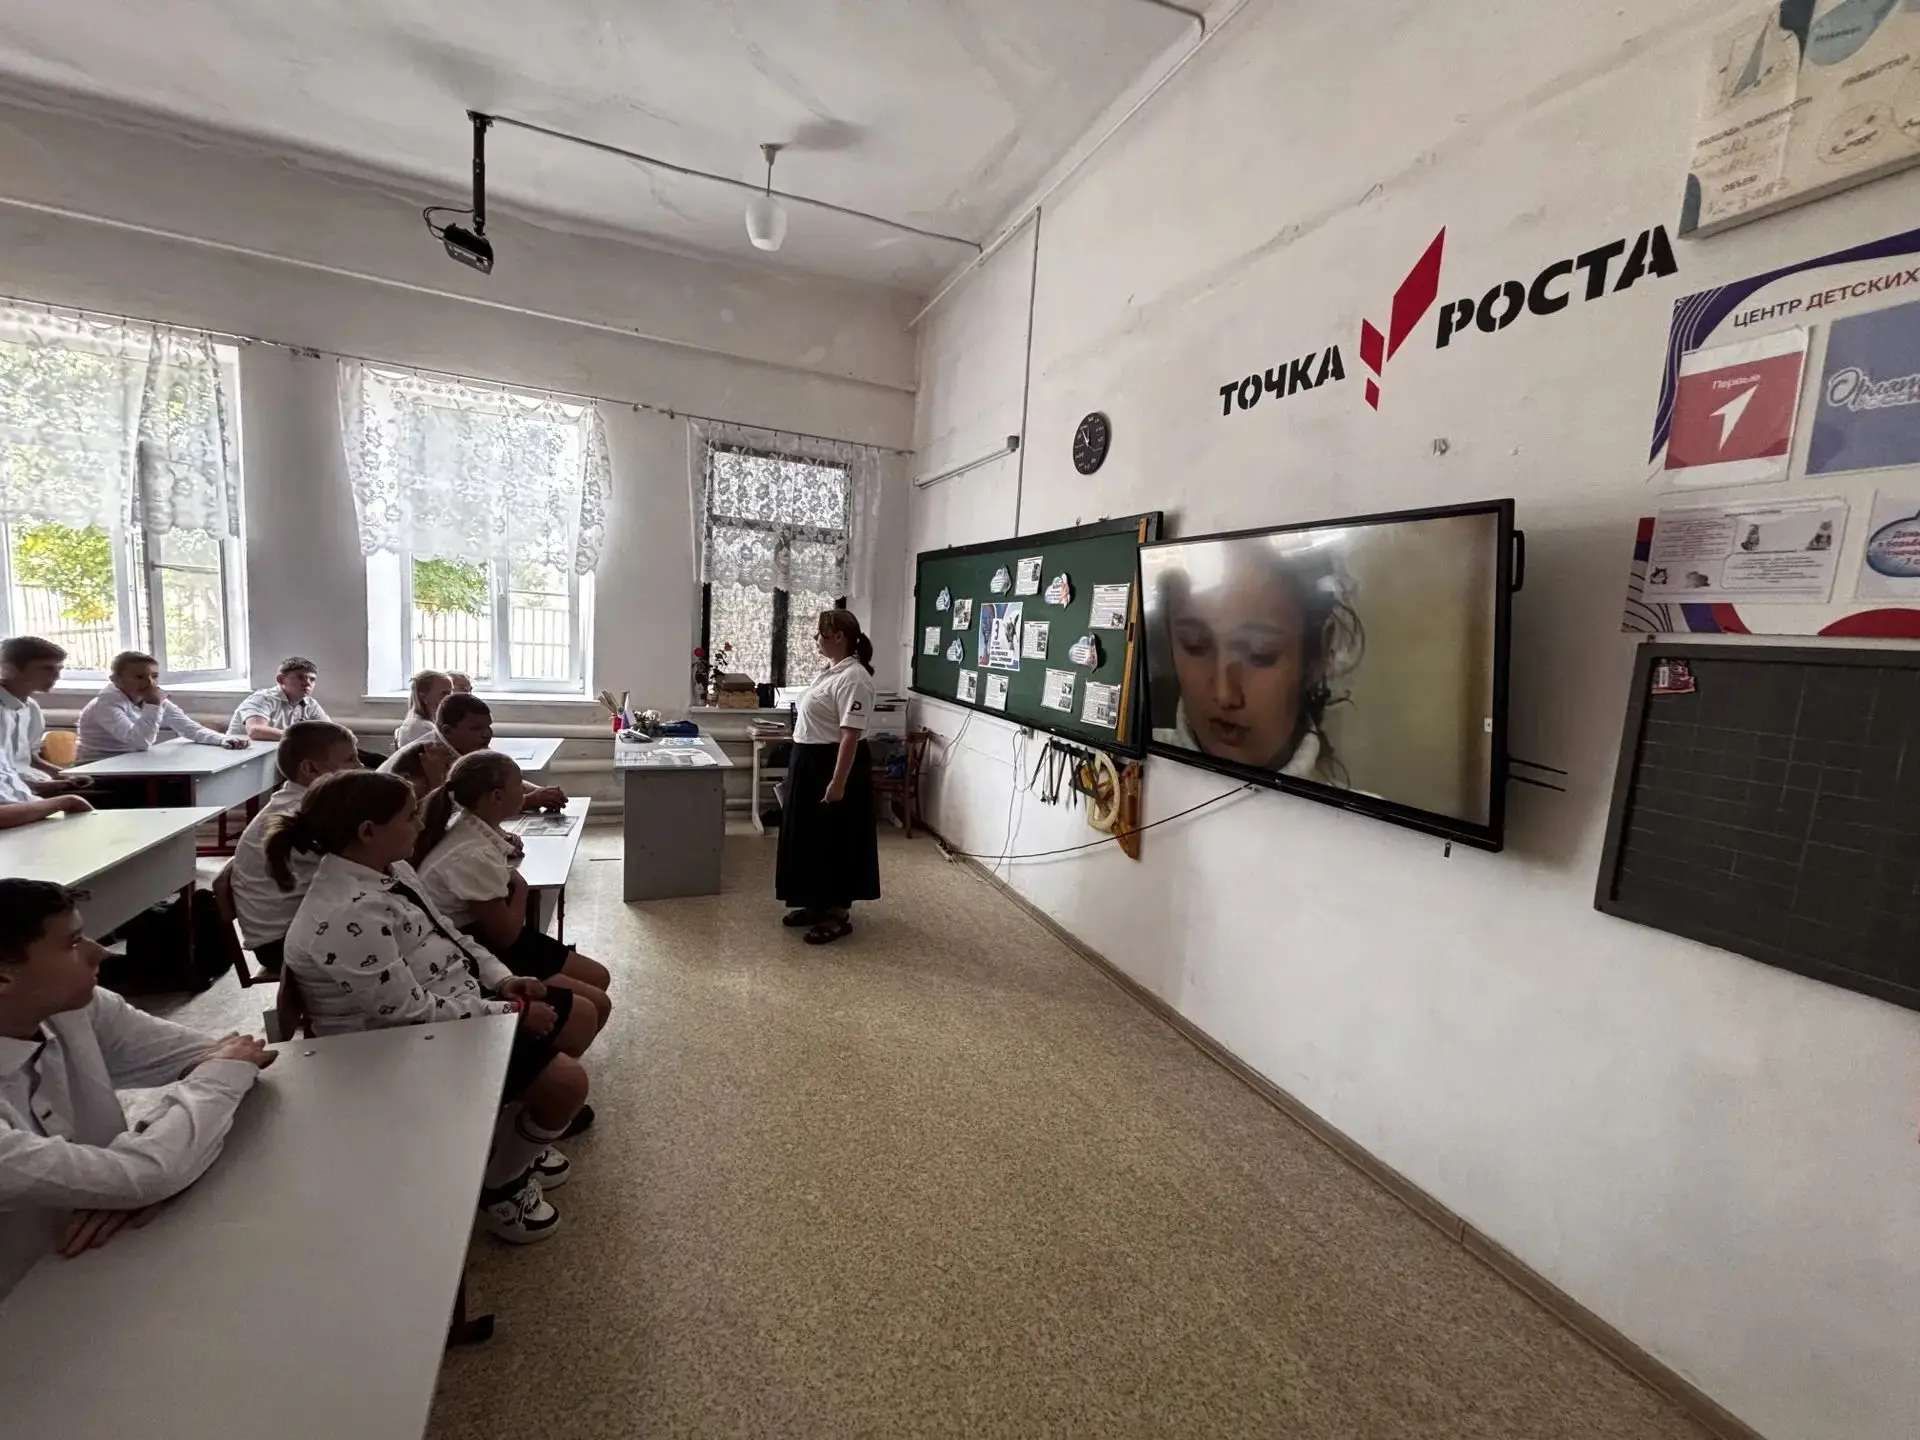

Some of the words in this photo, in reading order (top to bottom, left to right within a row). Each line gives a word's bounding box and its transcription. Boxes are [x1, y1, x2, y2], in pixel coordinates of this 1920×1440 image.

[1219, 345, 1346, 416] ТОЧКА
[1436, 224, 1679, 350] РОСТА
[1733, 298, 1803, 328] ЦЕНТР
[1805, 267, 1920, 312] ДЕТСКИХ
